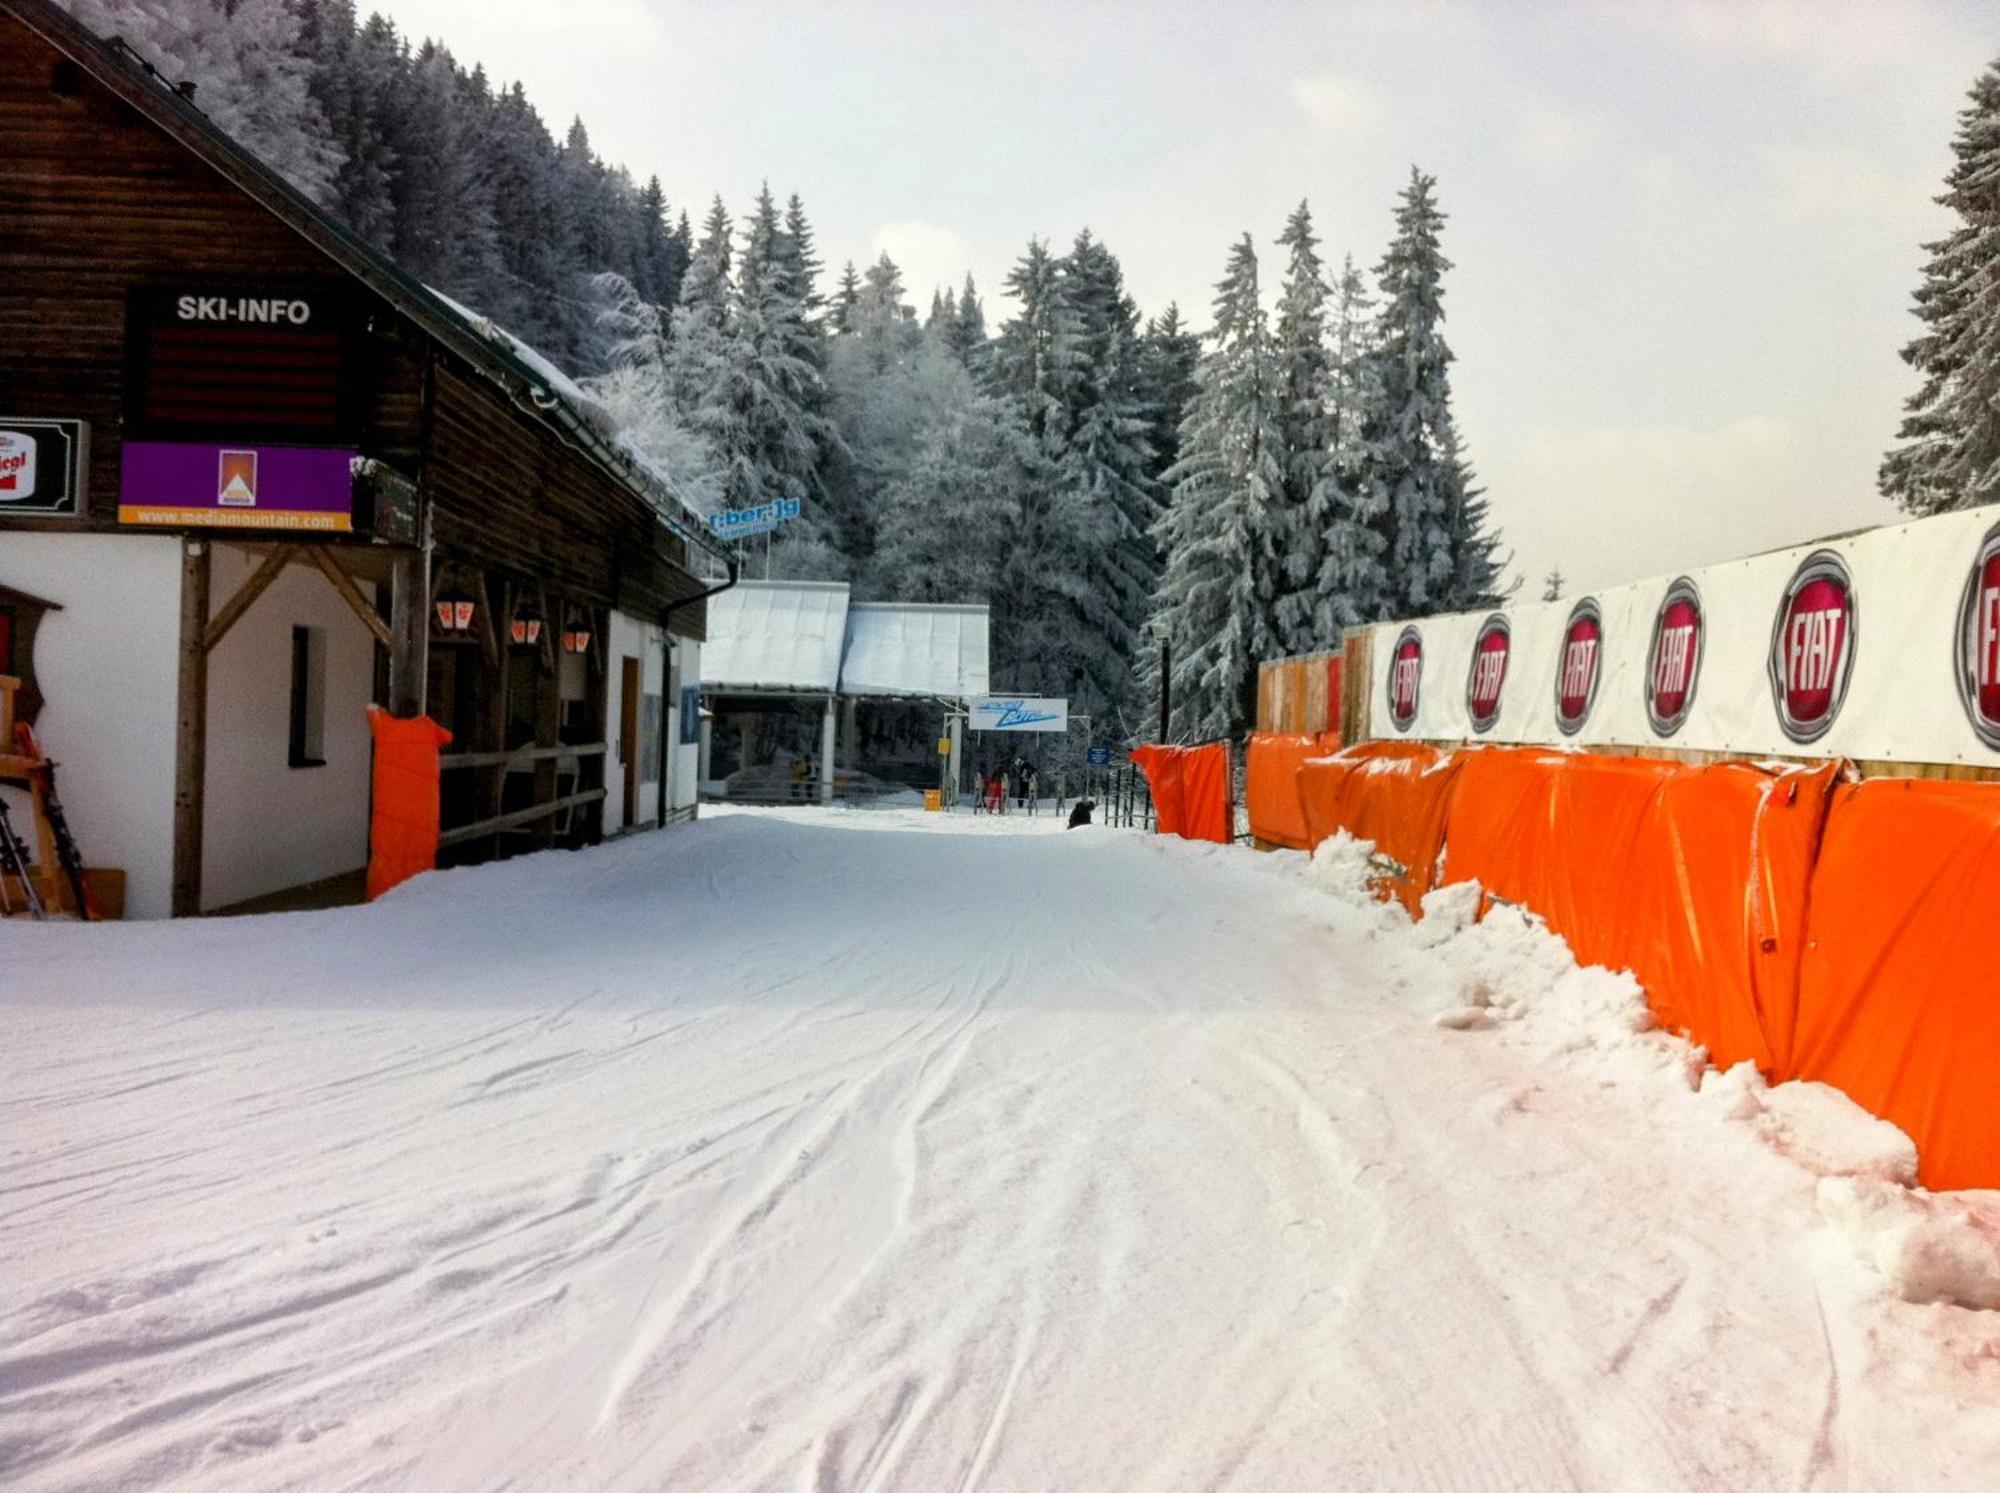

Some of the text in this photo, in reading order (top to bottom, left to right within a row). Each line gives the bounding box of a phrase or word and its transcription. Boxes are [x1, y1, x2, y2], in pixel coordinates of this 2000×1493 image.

[177, 296, 310, 325] SKI-INFO
[137, 508, 335, 529] www.mediamountain.com
[1563, 639, 1596, 697] FIAT
[1657, 625, 1693, 693] FIAT
[1789, 608, 1841, 691] FIAT
[1396, 658, 1419, 703] FIAT
[1474, 651, 1506, 700] FIAT
